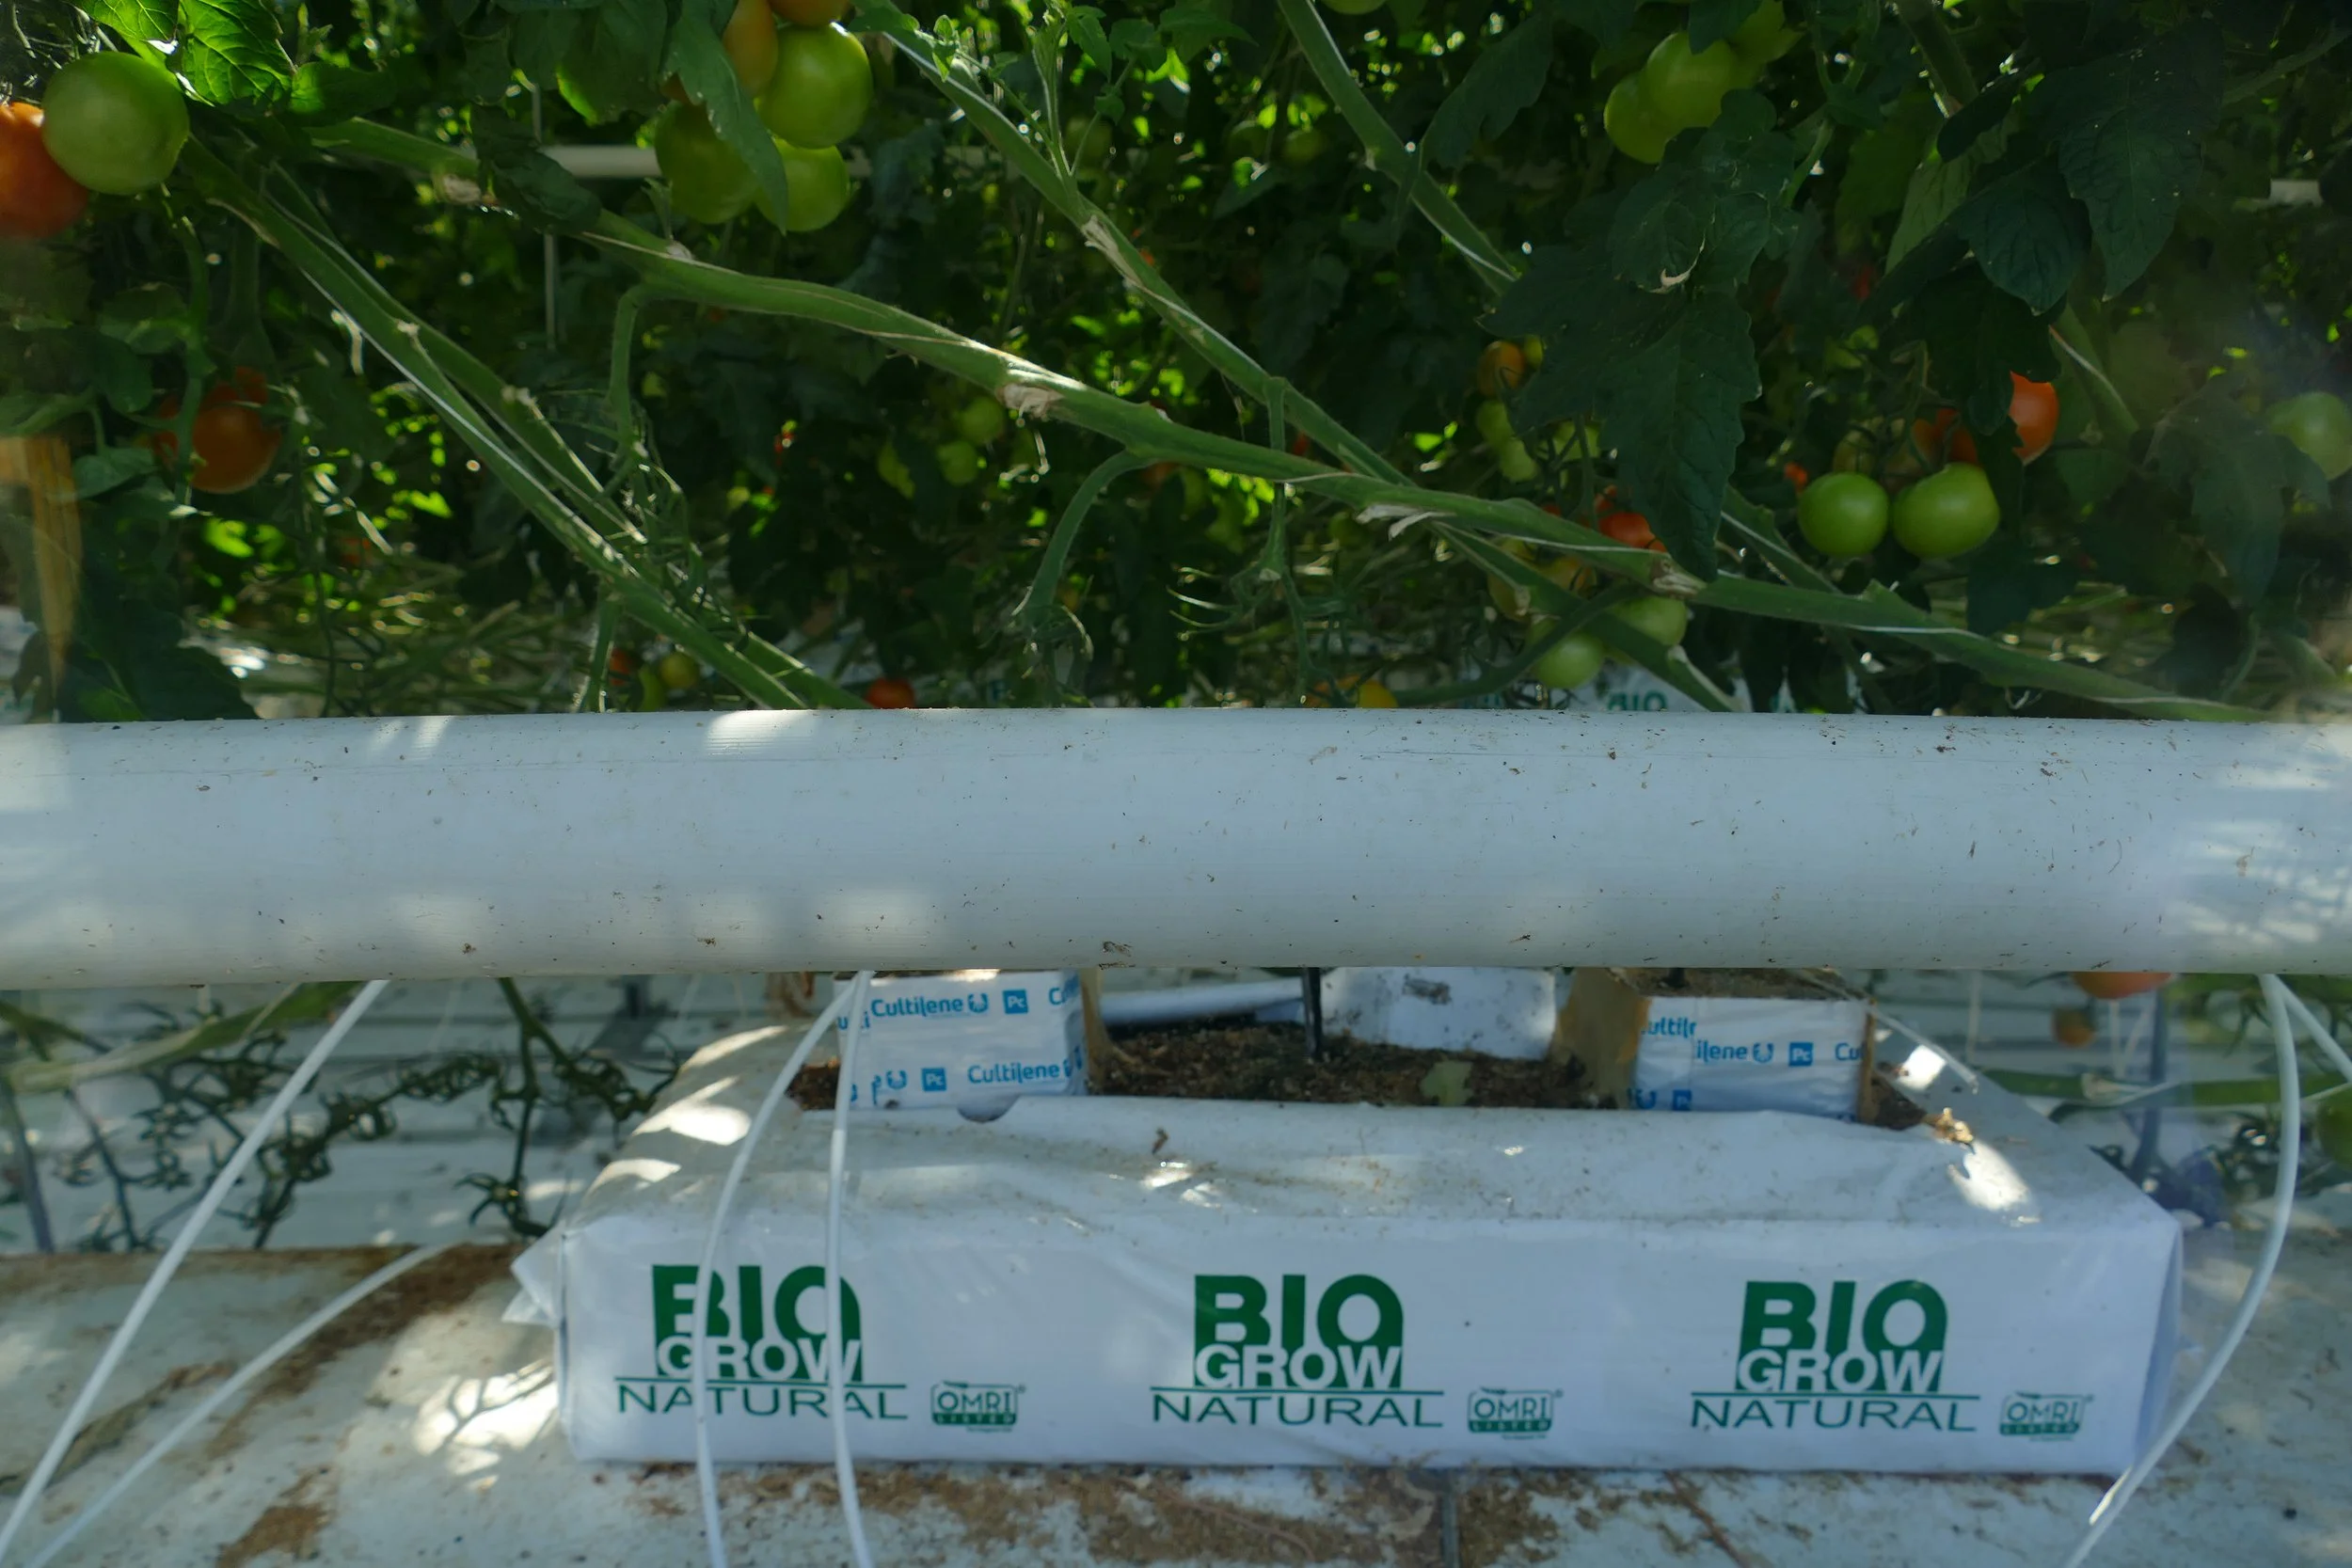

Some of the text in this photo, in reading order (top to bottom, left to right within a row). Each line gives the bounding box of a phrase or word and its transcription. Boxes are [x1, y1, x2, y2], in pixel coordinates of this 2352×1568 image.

[870, 995, 963, 1018] Cultilene
[967, 1063, 1059, 1085] Cultilene
[652, 1264, 862, 1339] BIO
[1195, 1275, 1404, 1347] BIO
[1740, 1279, 1947, 1352] BIO
[657, 1335, 861, 1380] GROW
[1195, 1343, 1402, 1389] GROW
[1737, 1348, 1942, 1392] GROW
[618, 1384, 909, 1420] NATURAL
[937, 1391, 1013, 1413] OMRI
[1152, 1394, 1444, 1428] NATURAL
[1474, 1397, 1549, 1419] OMRI
[1691, 1399, 1978, 1433] NATURAL
[2007, 1401, 2079, 1423] OMRI
